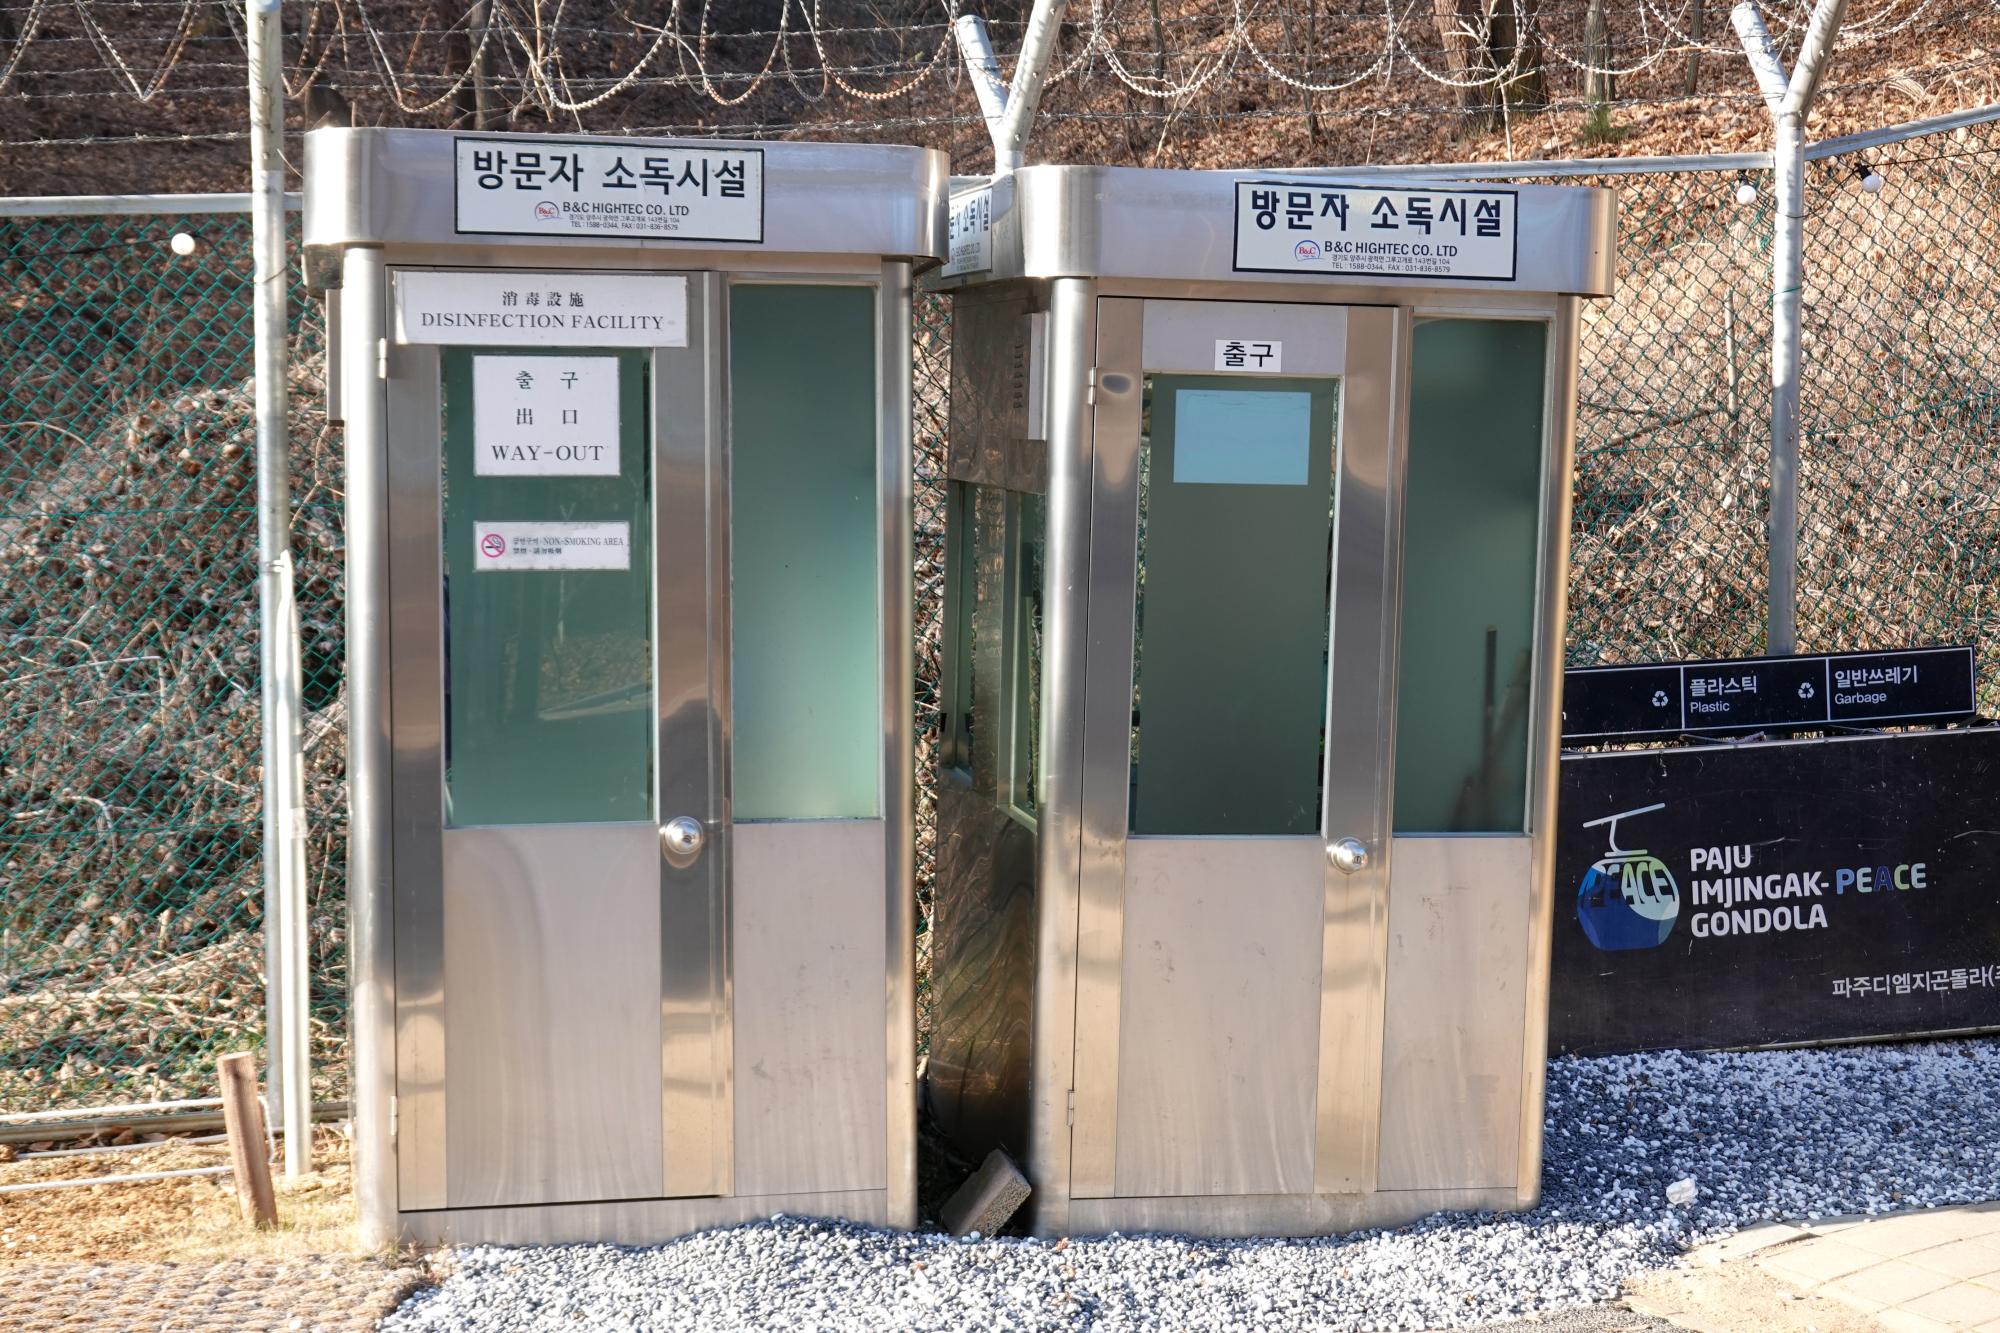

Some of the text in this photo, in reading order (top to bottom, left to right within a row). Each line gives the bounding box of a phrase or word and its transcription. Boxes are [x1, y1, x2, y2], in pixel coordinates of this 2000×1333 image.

[474, 150, 745, 198] 방문자 소독시설
[562, 201, 690, 216] B&C HIGHTEC CO. LTD
[1252, 190, 1501, 237] 방문자 소독시설
[1324, 241, 1458, 257] B&C HIGHTEC CO. LTD
[422, 312, 664, 330] DISINFECTION FACILITY
[1223, 342, 1274, 367] 출구
[492, 444, 604, 462] WAY-OUT
[604, 537, 624, 546] AREA
[1690, 676, 1758, 696] 플라스틱
[1834, 664, 1918, 689] 일반쓰레기
[1690, 700, 1730, 714] Plastic
[1834, 690, 1887, 706] Garbage
[1690, 844, 1752, 875] PAJU
[1690, 902, 1828, 938] GONDOLA
